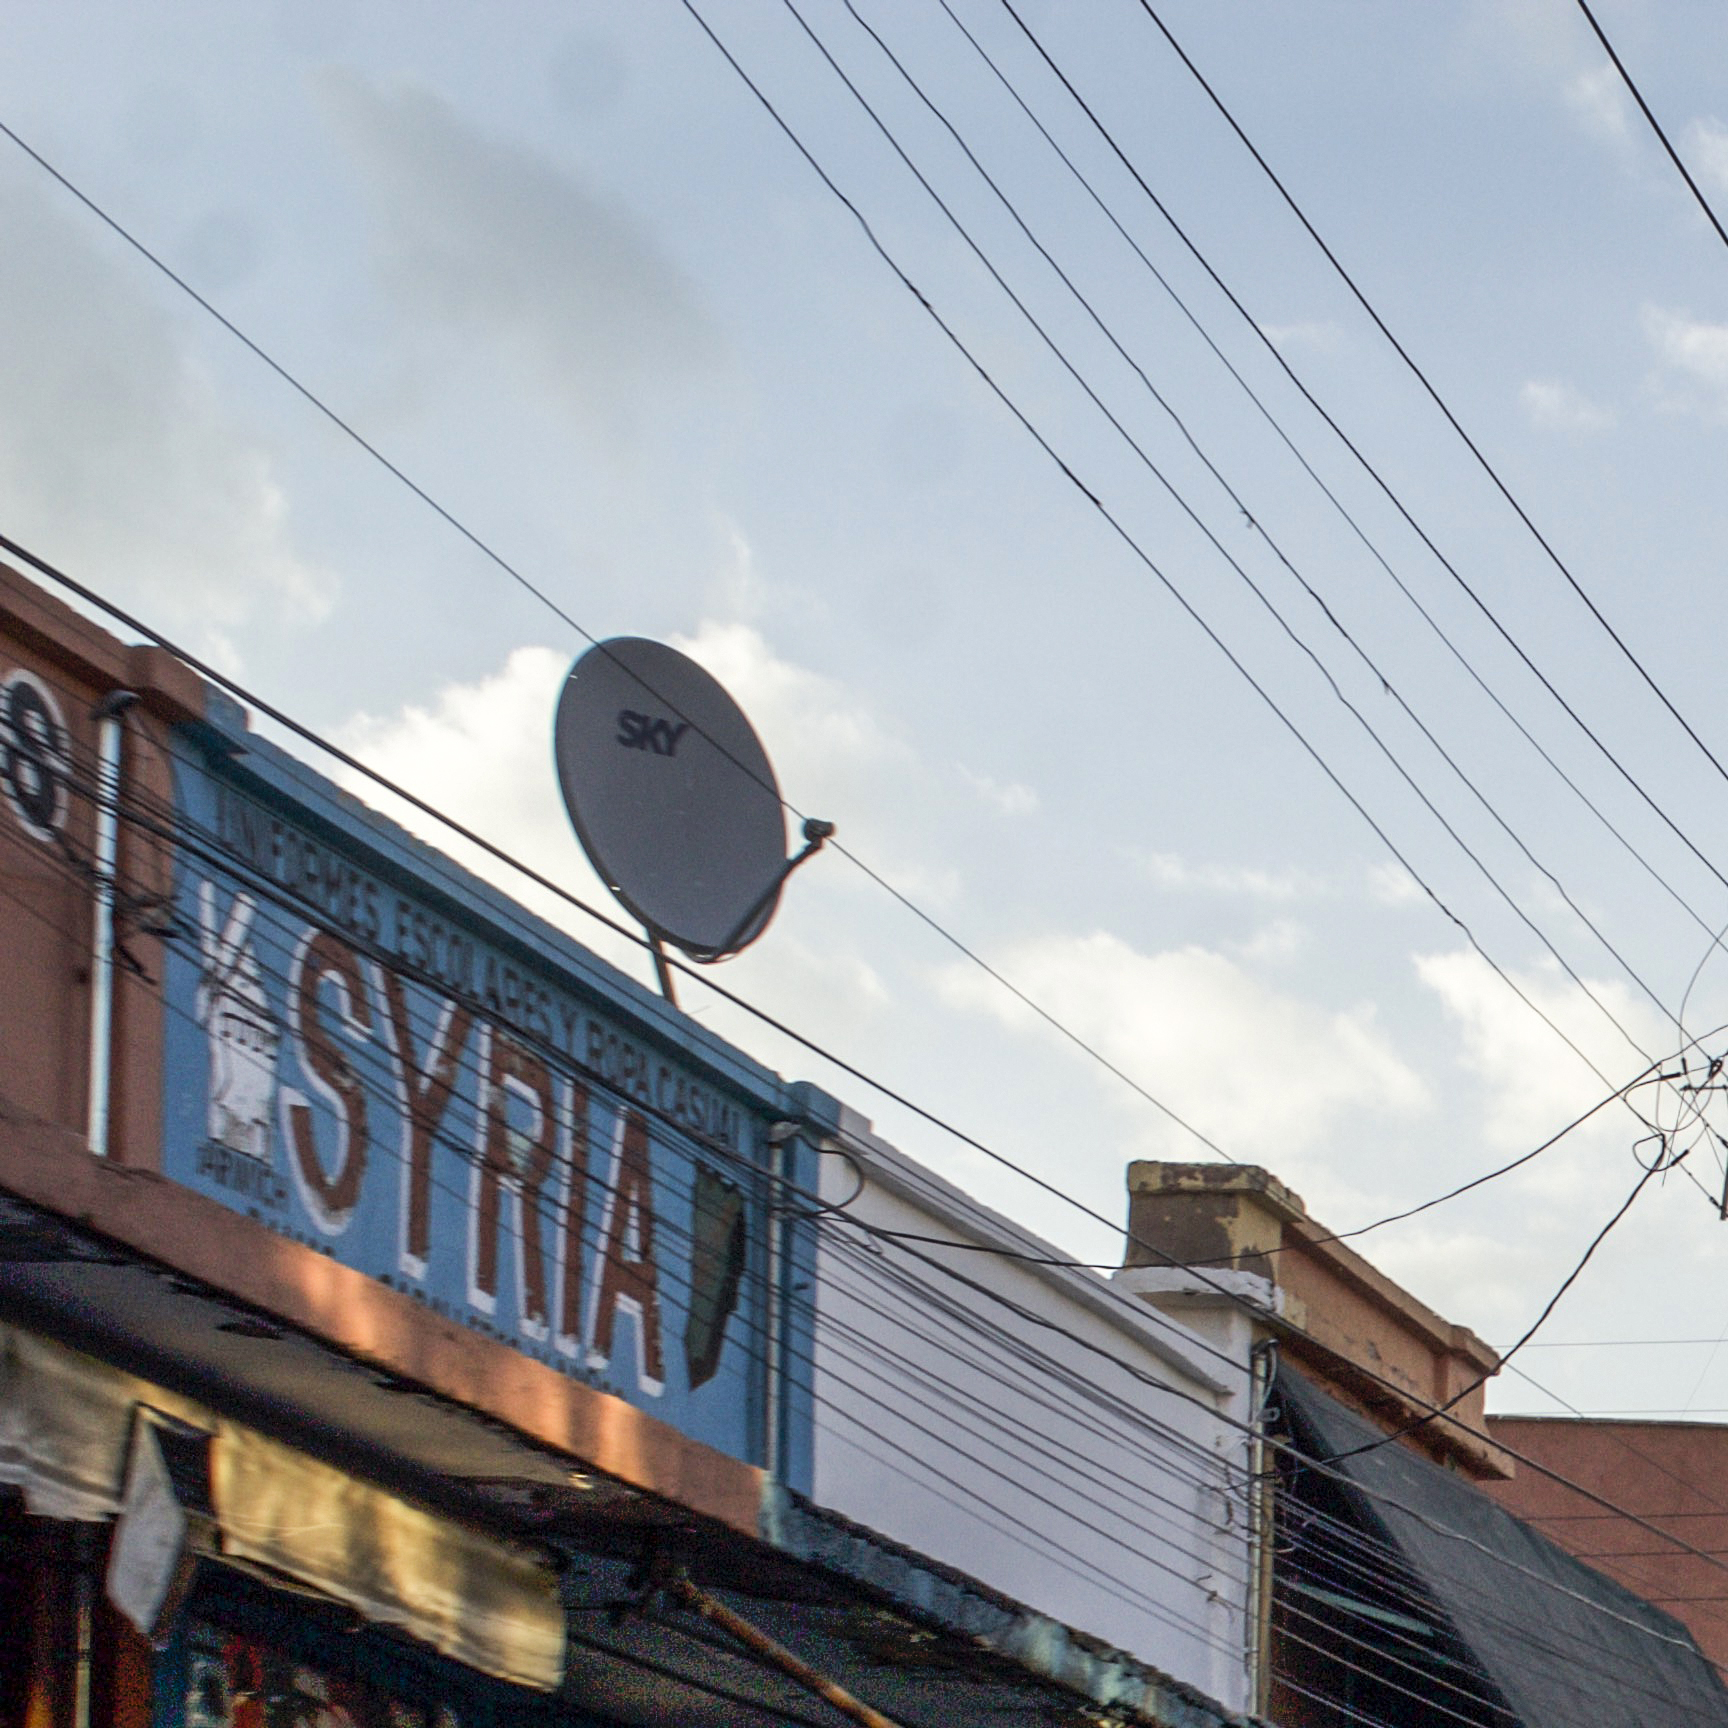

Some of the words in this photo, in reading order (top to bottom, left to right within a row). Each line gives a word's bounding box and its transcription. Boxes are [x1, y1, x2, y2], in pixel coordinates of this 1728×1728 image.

[616, 709, 688, 757] SKY
[397, 900, 553, 1040] ESCOLARES
[279, 928, 665, 1397] SYRIA
